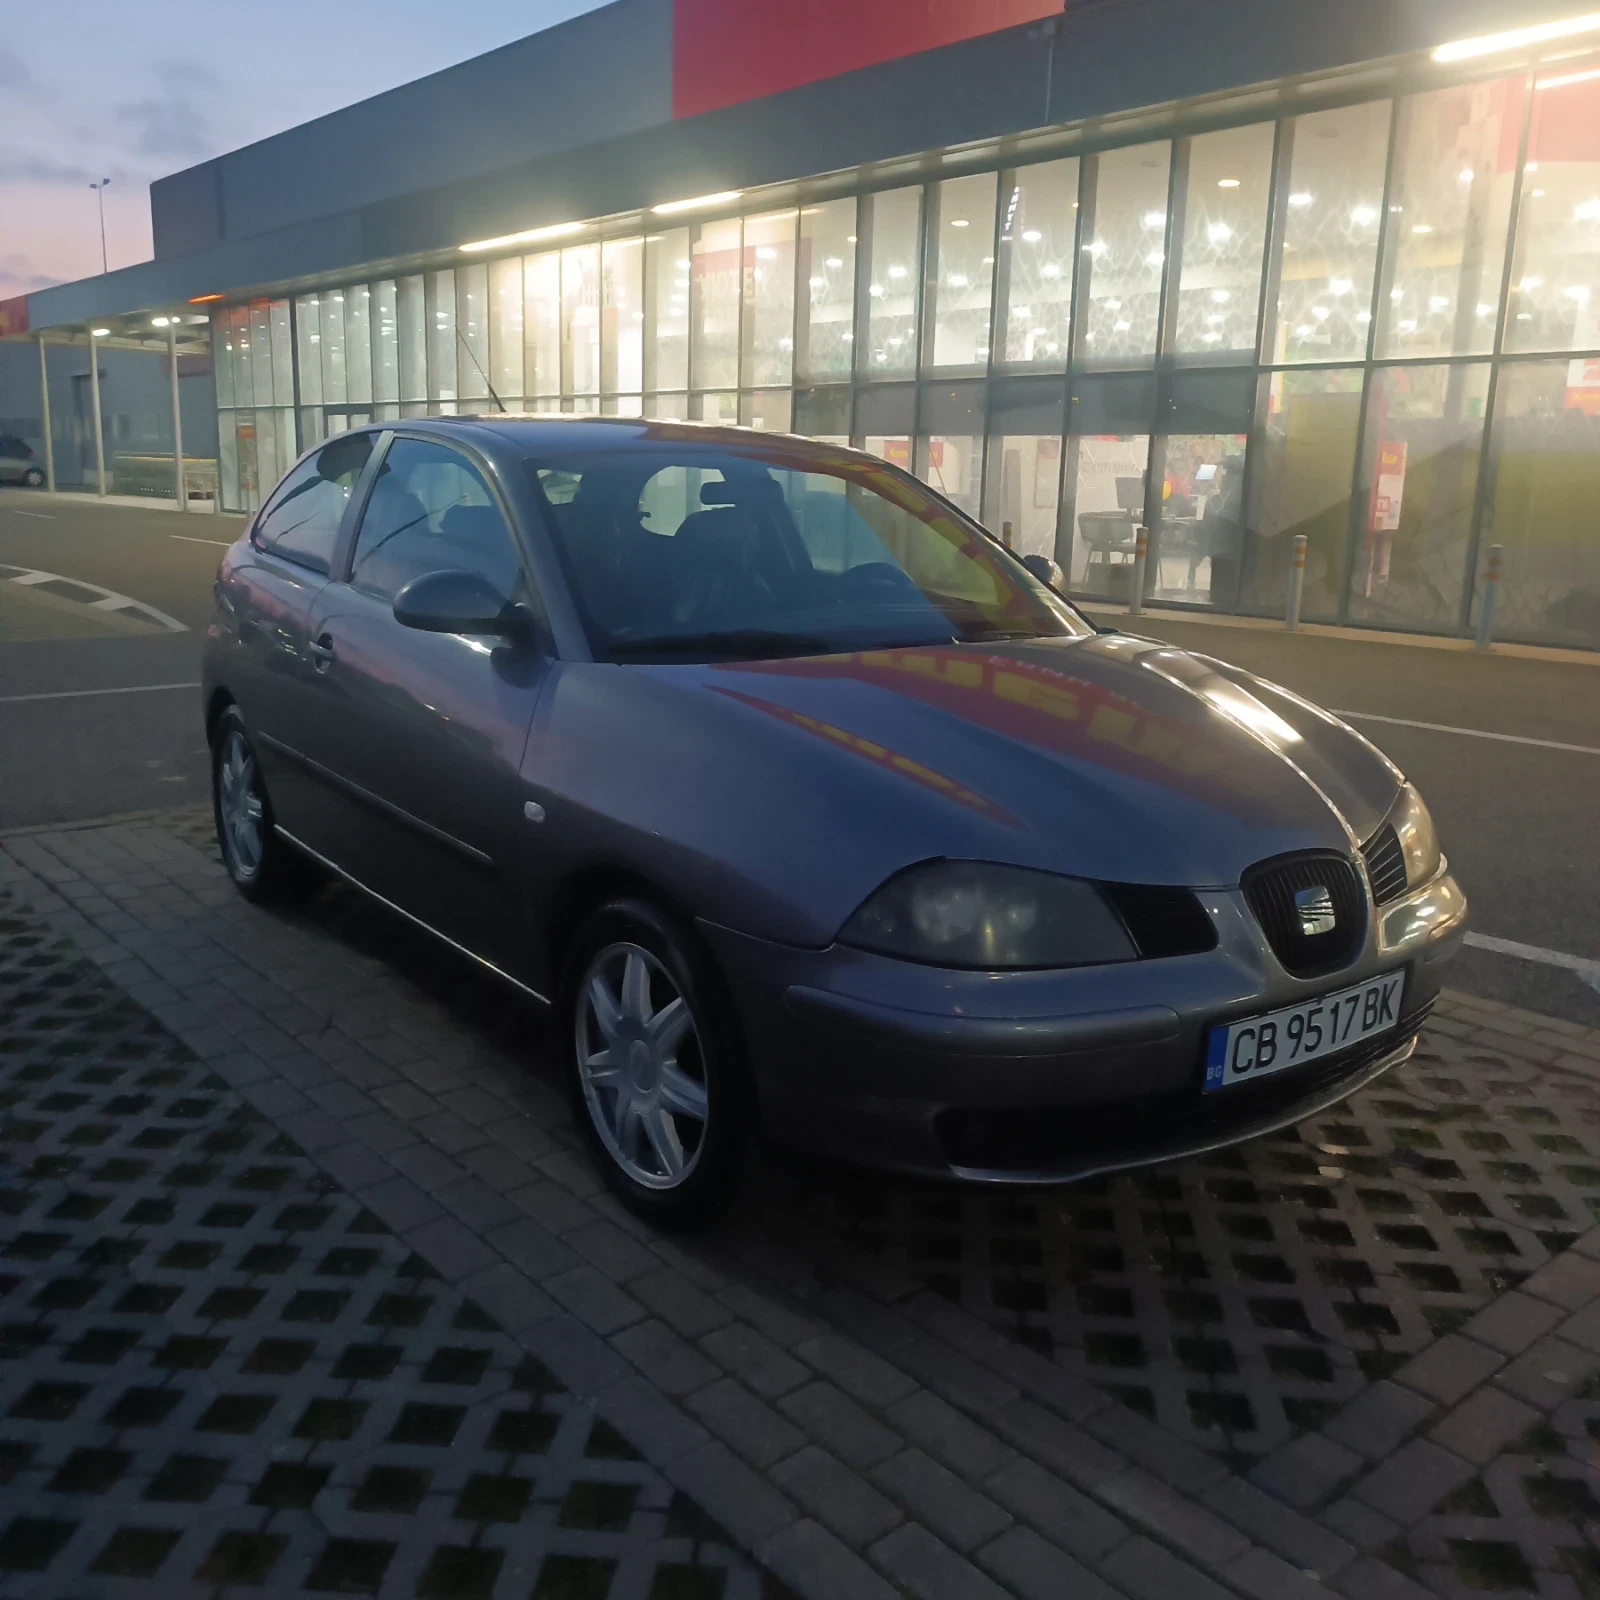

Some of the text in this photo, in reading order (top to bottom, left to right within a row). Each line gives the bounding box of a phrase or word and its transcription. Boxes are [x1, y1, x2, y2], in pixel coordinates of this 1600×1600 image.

[1231, 978, 1399, 1074] CB 9517 BK
[1206, 1064, 1222, 1081] BG
